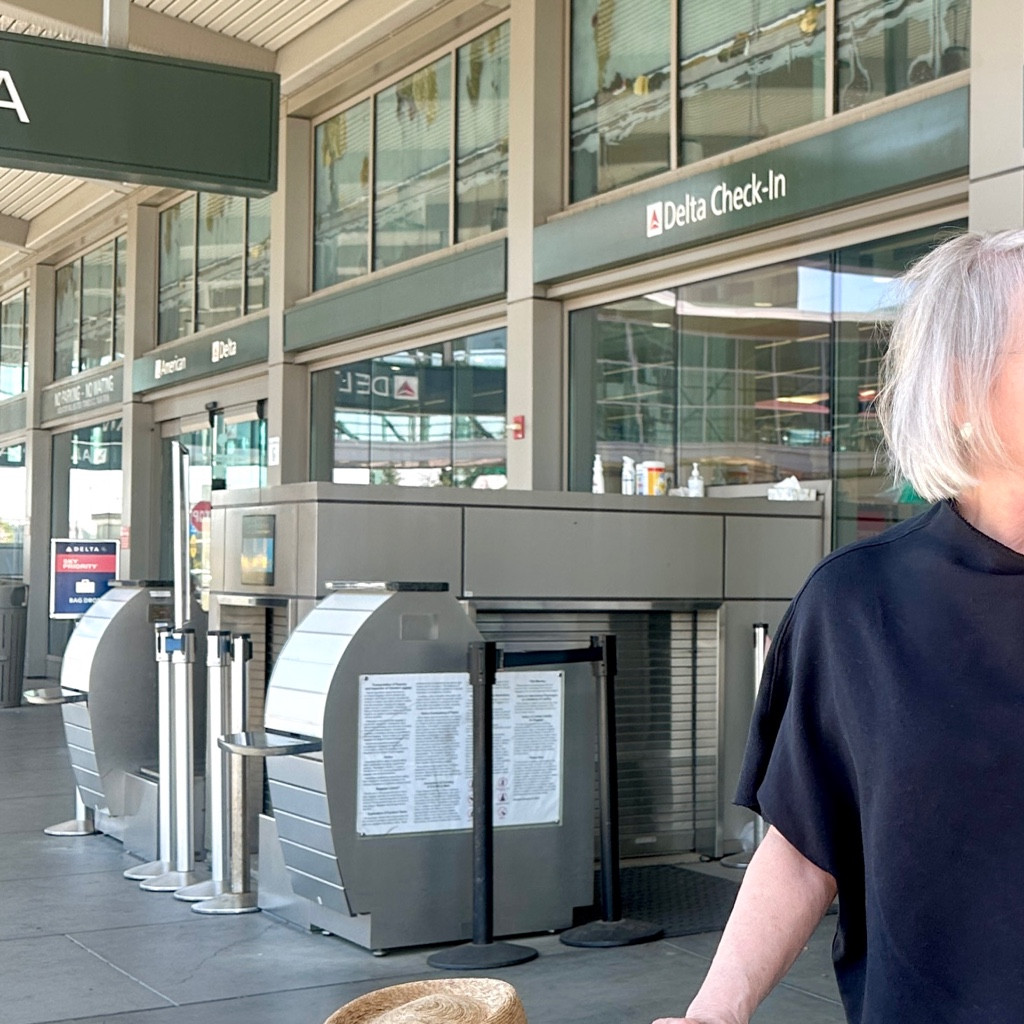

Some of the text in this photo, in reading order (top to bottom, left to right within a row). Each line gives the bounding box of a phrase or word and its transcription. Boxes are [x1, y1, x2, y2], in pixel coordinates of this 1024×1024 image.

[664, 169, 786, 230] Delta Check-In
[219, 338, 236, 358] Delta
[161, 356, 186, 375] American
